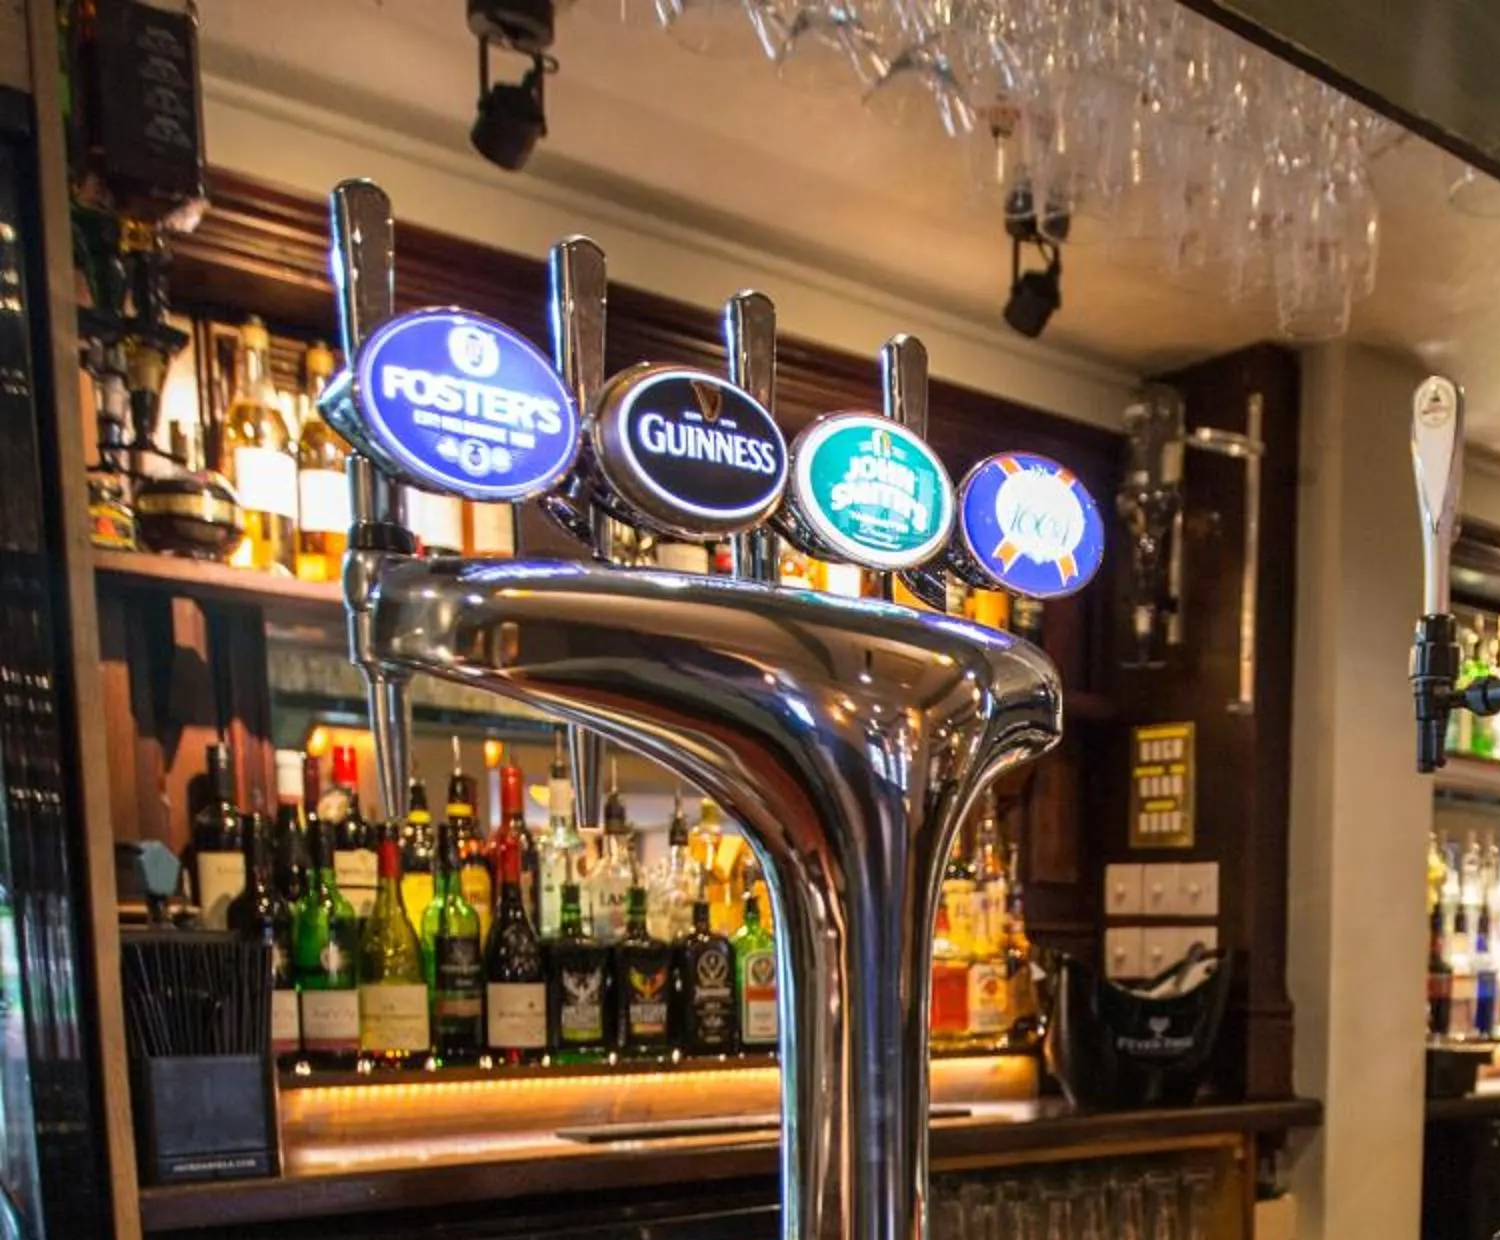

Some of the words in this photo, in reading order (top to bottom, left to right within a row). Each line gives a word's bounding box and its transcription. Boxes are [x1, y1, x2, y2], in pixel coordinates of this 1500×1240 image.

[382, 364, 562, 435] FOSTER'S
[638, 412, 777, 475] GUINNESS
[843, 455, 916, 499] JOHN
